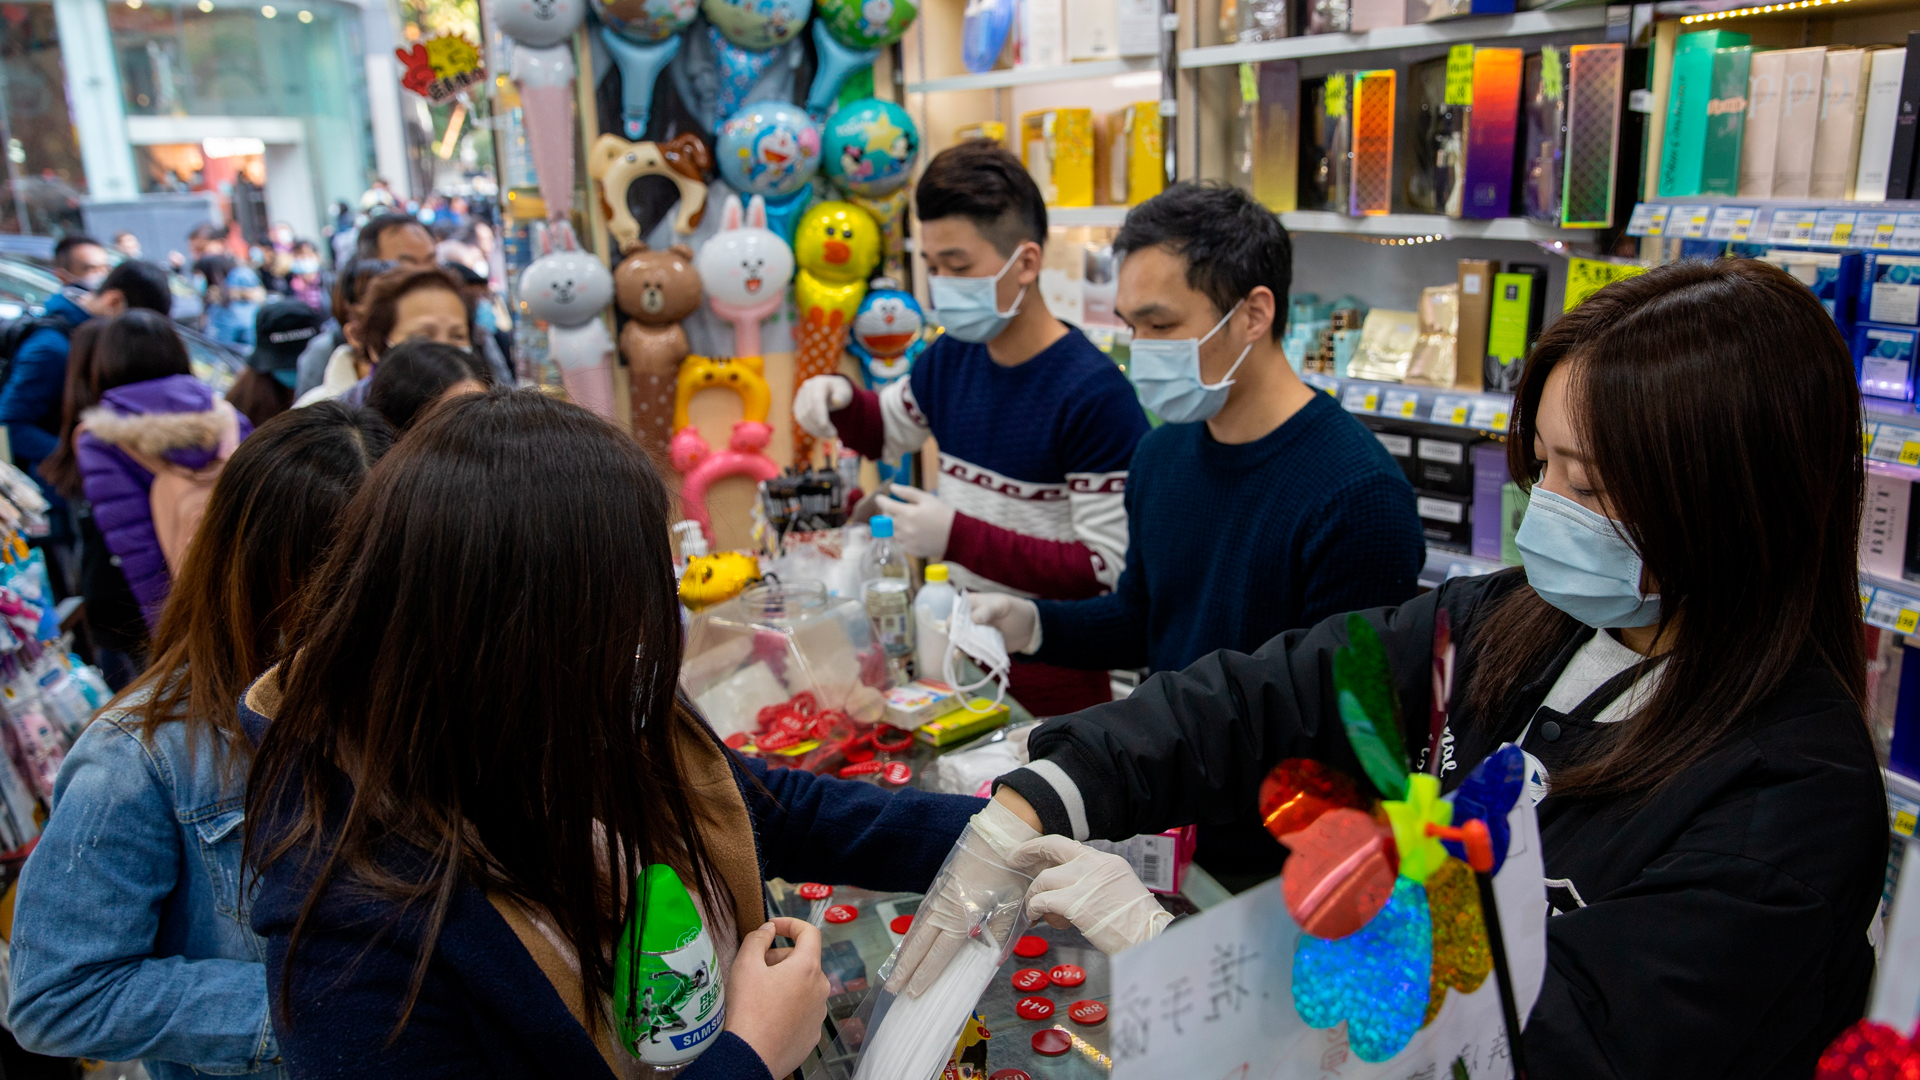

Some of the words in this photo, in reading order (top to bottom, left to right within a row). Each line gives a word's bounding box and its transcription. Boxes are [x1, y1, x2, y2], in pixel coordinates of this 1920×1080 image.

[1053, 970, 1081, 979] 094
[1020, 999, 1050, 1014] 044
[1074, 1003, 1103, 1018] 088
[683, 1005, 725, 1046] SAMSUN
